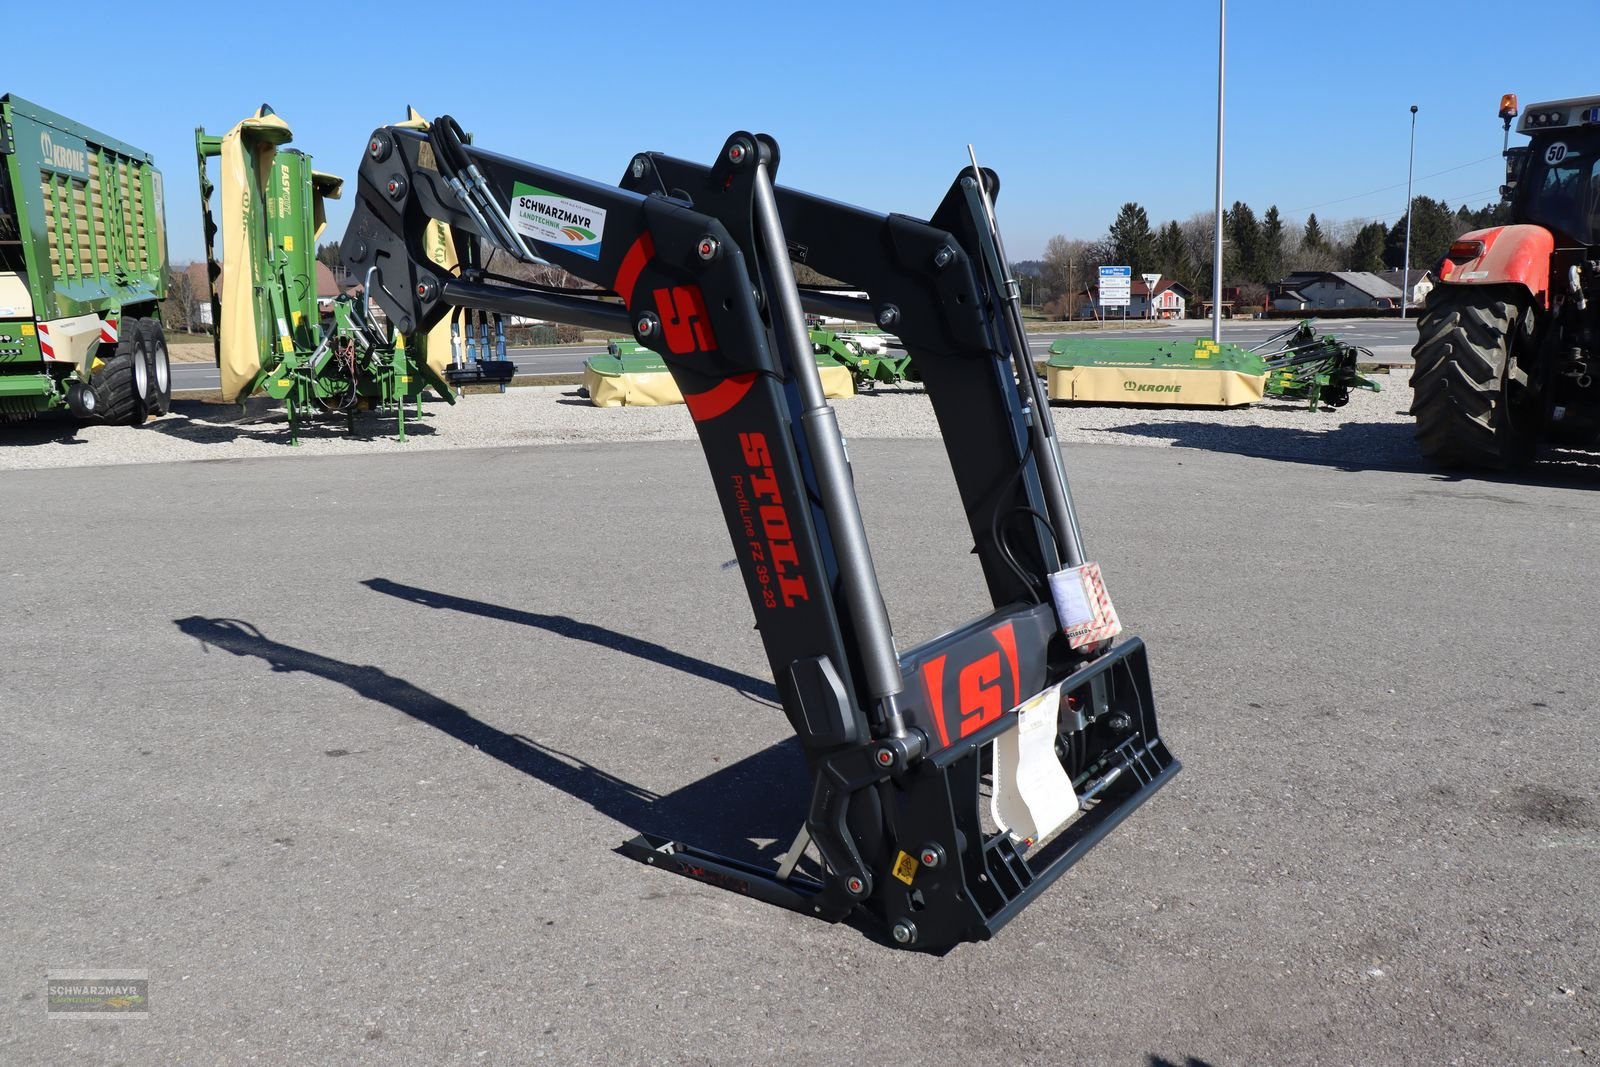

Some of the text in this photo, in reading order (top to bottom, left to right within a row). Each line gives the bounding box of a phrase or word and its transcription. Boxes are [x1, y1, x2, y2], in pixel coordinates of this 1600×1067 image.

[53, 144, 84, 173] KRONE
[1547, 145, 1565, 162] 50
[519, 197, 591, 228] SCHWARZMAYR
[519, 210, 560, 230] LANDTECHNIK
[653, 284, 718, 353] S
[1137, 384, 1182, 392] KRONE
[738, 432, 810, 608] STOLL
[731, 474, 776, 608] ProfiLine FZ 39-23
[960, 651, 1003, 738] S
